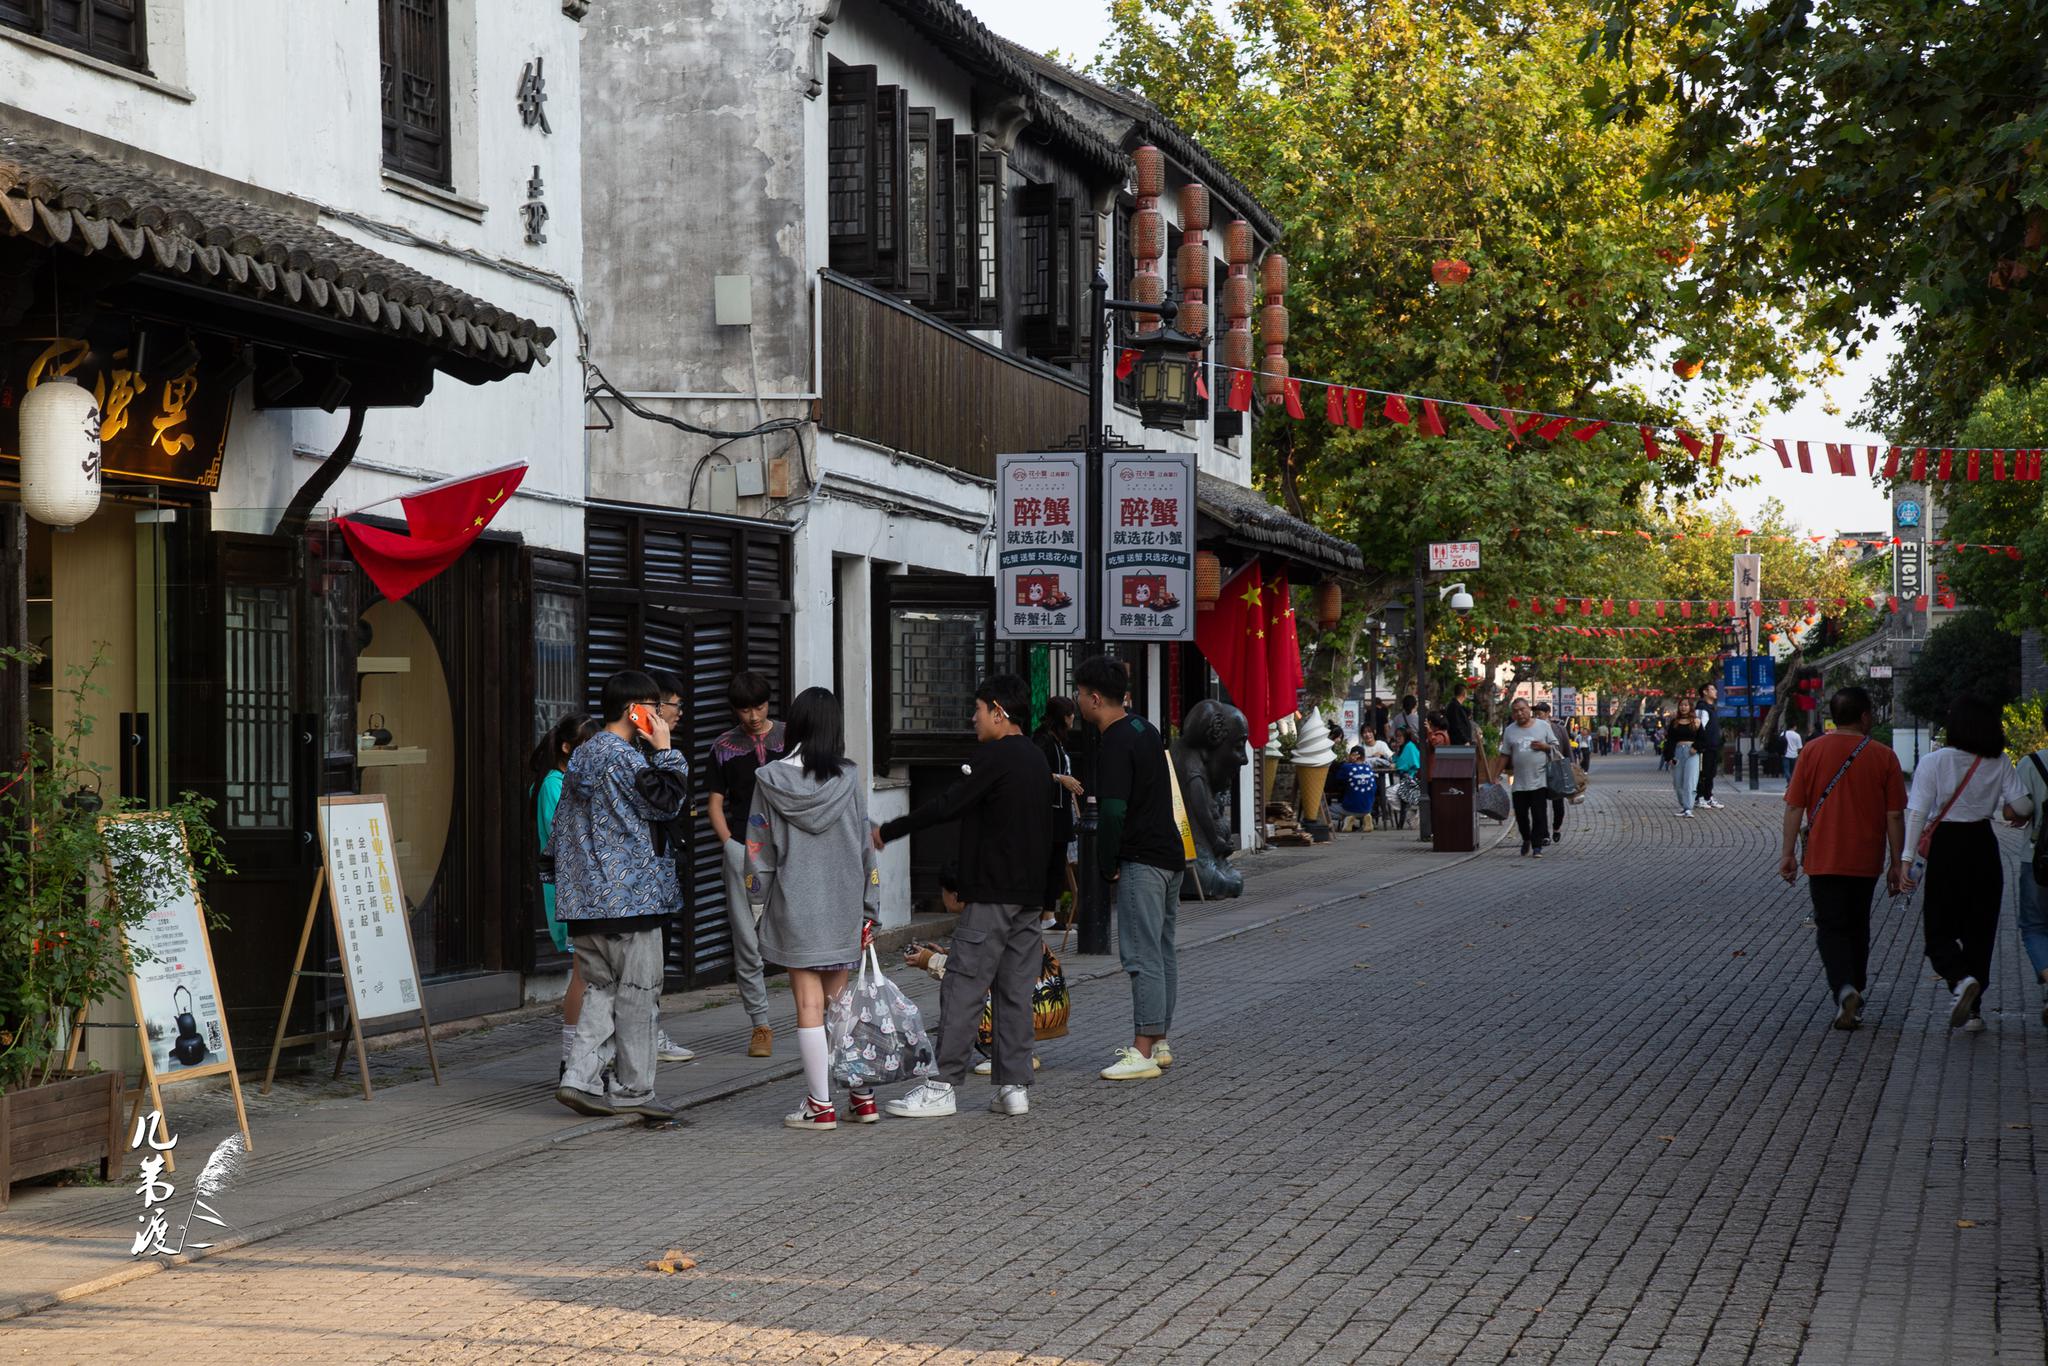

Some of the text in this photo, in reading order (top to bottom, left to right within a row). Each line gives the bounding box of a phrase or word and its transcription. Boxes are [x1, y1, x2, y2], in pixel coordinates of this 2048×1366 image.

[1013, 496, 1071, 527] 醉蟹
[1120, 497, 1179, 527] 醉蟹
[1007, 530, 1075, 545] 就选花小蟹
[1113, 531, 1183, 545] 就选花小蟹
[1450, 543, 1479, 553] 洗手间
[1002, 552, 1078, 564] 吃蟹 送蟹 只选花小蟹
[1108, 553, 1186, 565] 吃蟹 送蟹 只选花小蟹
[1452, 558, 1477, 567] 260m
[1901, 541, 1920, 601] Ellen's
[1013, 612, 1067, 626] 醉蟹礼盒
[1120, 613, 1174, 627] 醉蟹礼盒
[368, 817, 395, 914] 开业大酬宾
